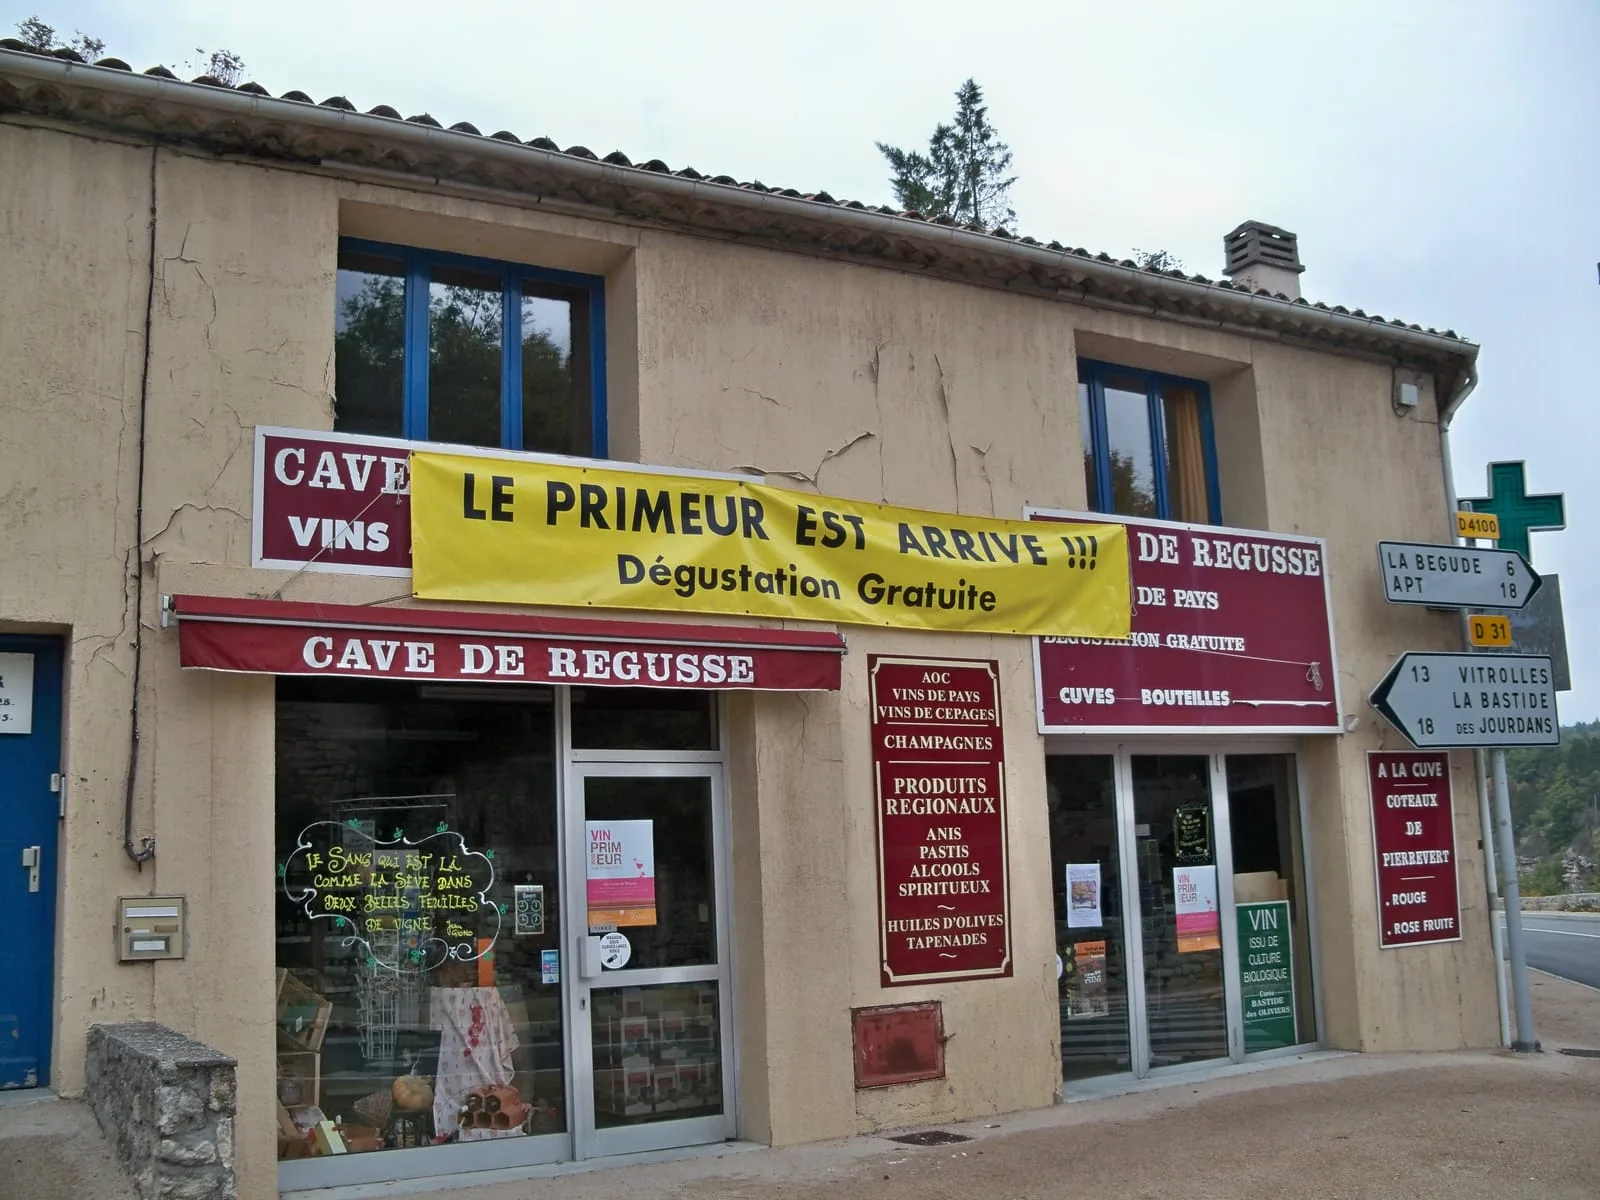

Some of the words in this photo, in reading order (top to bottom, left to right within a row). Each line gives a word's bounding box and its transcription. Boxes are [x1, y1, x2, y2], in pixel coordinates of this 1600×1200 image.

[274, 448, 410, 495] CAVE
[463, 472, 514, 522] LE
[546, 480, 769, 541] PRIMEUR
[796, 504, 866, 550] EST
[898, 522, 1048, 566] ARRIVE
[288, 515, 390, 552] VINS
[1137, 532, 1179, 565] DE
[1191, 538, 1321, 577] REGUSSE
[1388, 552, 1409, 570] LA
[1416, 554, 1482, 574] BEGUDE
[1507, 561, 1515, 576] 6
[617, 554, 841, 598] Dégustation
[857, 573, 996, 611] Gratuite
[1393, 576, 1424, 594] APT
[1500, 582, 1518, 599] 18
[1137, 586, 1166, 606] DE
[1173, 589, 1219, 610] PAYS
[1166, 633, 1246, 651] GRATUITE
[302, 636, 435, 673] CAVE
[459, 643, 525, 676] DE
[548, 646, 755, 683] REGUSSE
[922, 672, 951, 684] AOC
[1411, 665, 1430, 683] 13
[1458, 666, 1549, 685] VITROLLES
[892, 688, 925, 701] VINS
[928, 689, 946, 702] DE
[949, 690, 981, 703] PAYS
[1059, 687, 1115, 705] CUVES
[1140, 688, 1230, 706] BOUTEILLES
[1453, 692, 1472, 709] LA
[1481, 692, 1549, 709] BASTIDE
[878, 706, 911, 718] VINS
[914, 707, 933, 719] DE
[935, 707, 996, 721] CEPAGES
[1417, 718, 1435, 735] 18
[1456, 723, 1475, 735] DES
[1479, 717, 1553, 734] JOURDANS
[884, 735, 993, 750] CHAMPAGNES
[1378, 762, 1388, 778] A
[1392, 763, 1408, 778] LA
[1412, 762, 1443, 778] CUVE
[894, 777, 987, 794] PRODUITS
[885, 797, 996, 815] REGIONAUX
[1386, 793, 1439, 809] COTEAUX
[591, 829, 611, 841] VIN
[926, 827, 962, 841] ANIS
[1405, 821, 1423, 836] DE
[591, 842, 622, 853] PRIM
[920, 845, 969, 859] PASTIS
[305, 852, 324, 871] LE
[405, 853, 434, 871] EST
[597, 853, 622, 865] EUR
[1382, 849, 1450, 867] PIERREVERT
[910, 862, 981, 878] ALCOOLS
[314, 874, 363, 888] COMME
[370, 874, 389, 888] LA
[437, 875, 473, 891] DANS
[1177, 874, 1190, 884] VIN
[899, 880, 991, 896] SPIRITUEUX
[324, 895, 357, 912] DEUX
[364, 894, 410, 913] BELLES
[1392, 891, 1427, 906] ROUGE
[365, 918, 384, 932] DE
[888, 917, 940, 933] HUILES
[943, 914, 1004, 930] D'OLIVES
[1248, 908, 1278, 931] VIN
[1394, 921, 1420, 935] ROSE
[1423, 917, 1454, 932] FRUITE
[906, 932, 988, 950] TAPENADES
[1249, 937, 1266, 949] ISSU
[1267, 936, 1279, 947] DE
[1248, 952, 1281, 966] CULTURE
[1243, 967, 1288, 983] BIOLOGIQUE
[1251, 996, 1285, 1008] BASTIDE
[1258, 1005, 1291, 1017] OLIVIERS
